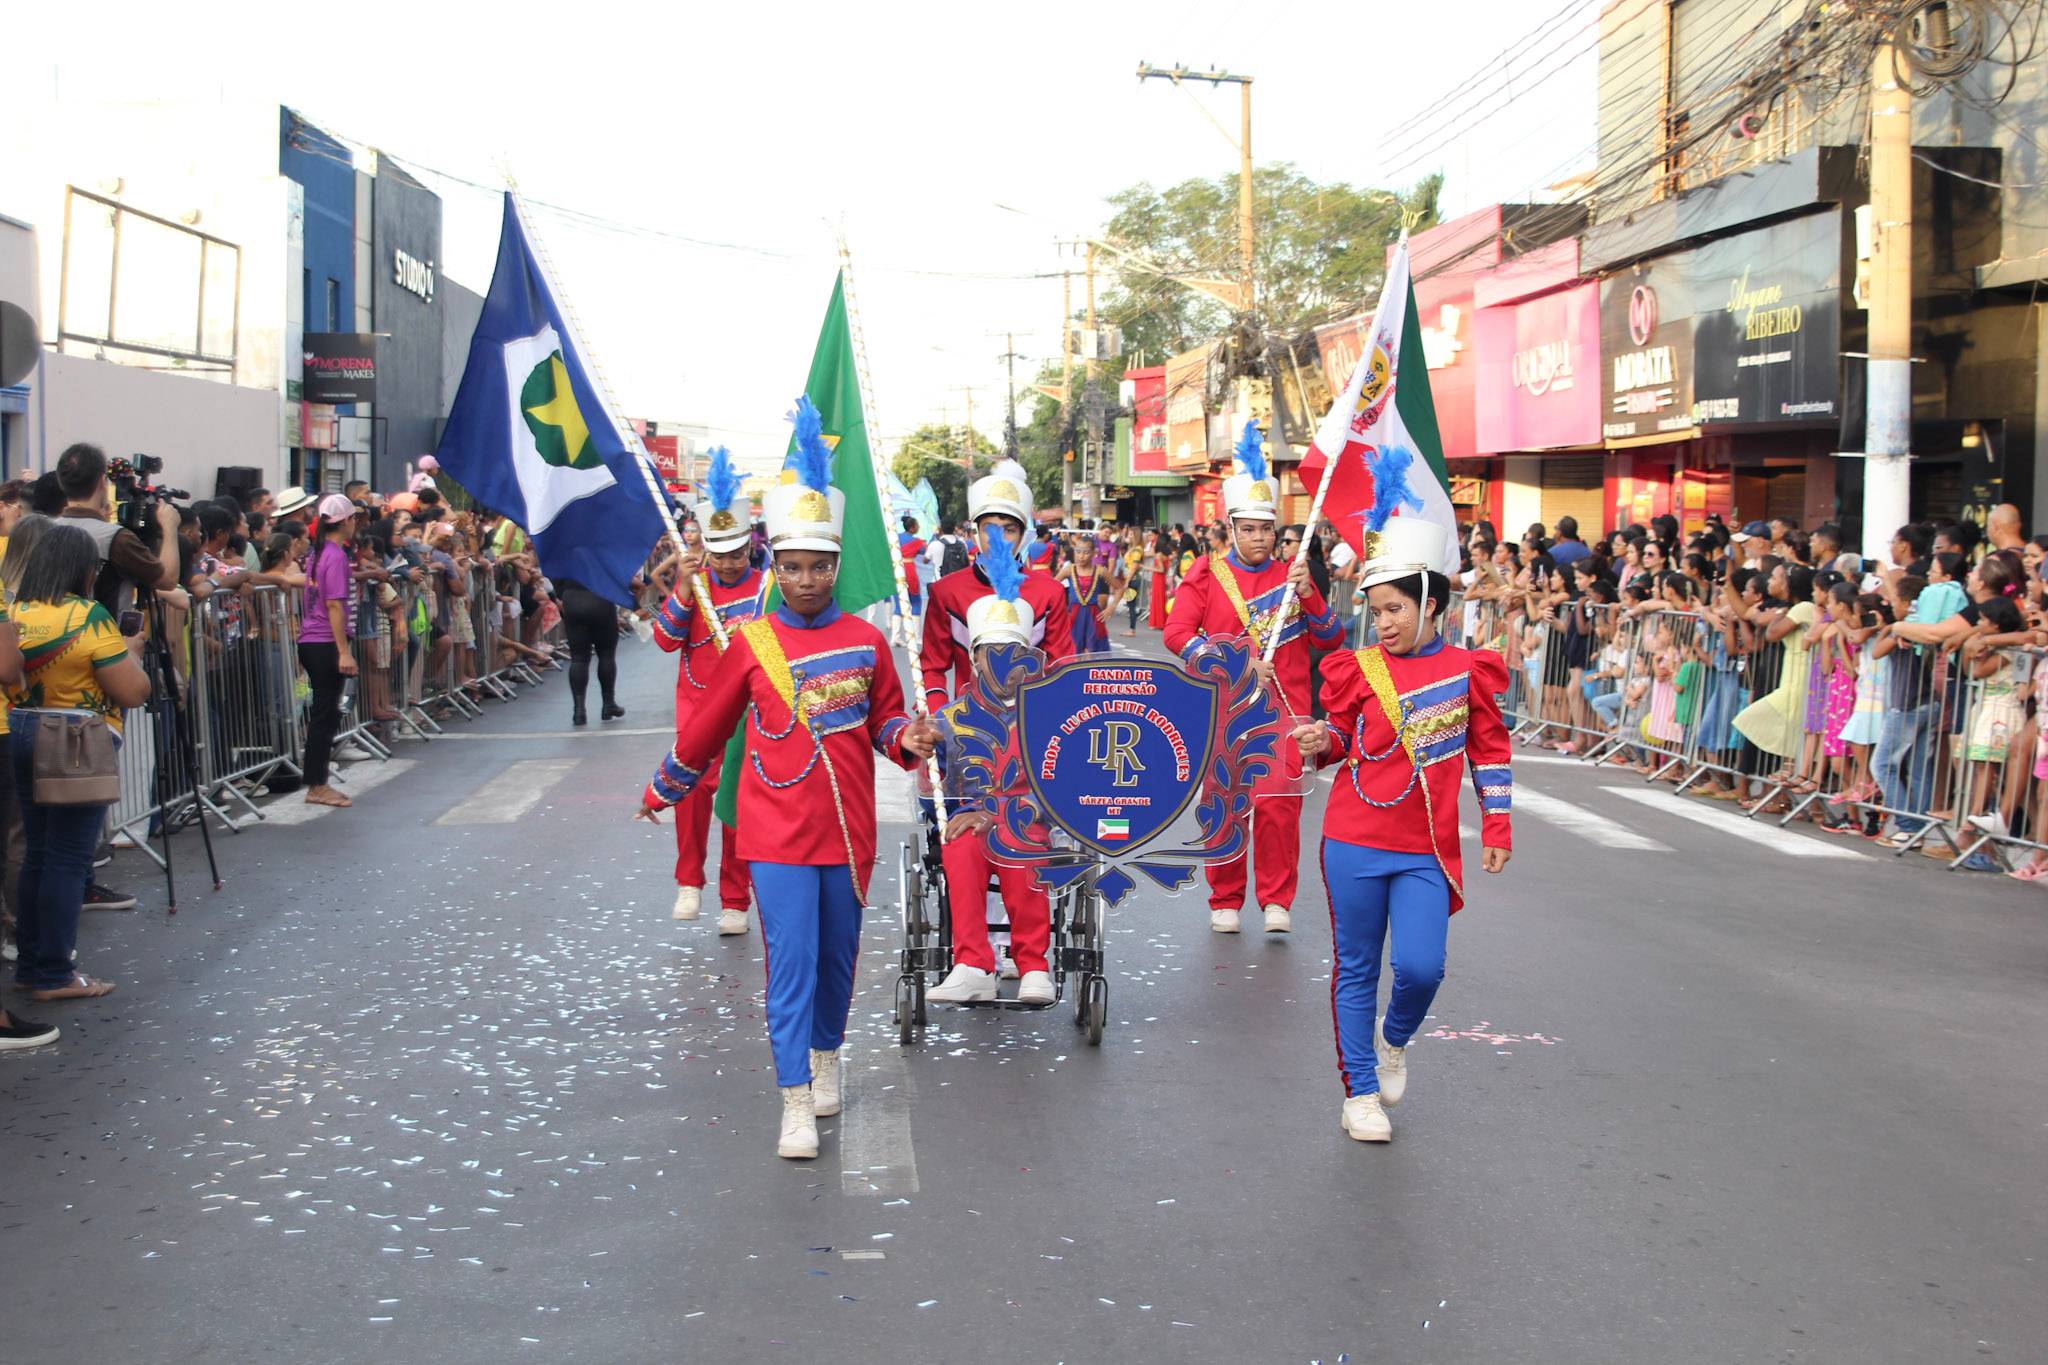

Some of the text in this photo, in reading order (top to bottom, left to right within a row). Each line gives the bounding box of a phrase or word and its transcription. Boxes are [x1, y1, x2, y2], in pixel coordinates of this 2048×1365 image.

[395, 248, 426, 298] STUDIO
[1745, 304, 1802, 340] RIBEIRO
[314, 356, 374, 371] MORENA
[343, 369, 375, 380] MAKES
[1089, 669, 1153, 681] BANDA DE
[1083, 682, 1157, 695] PERCUSSÃO
[1060, 703, 1103, 736] LUCIA
[1103, 700, 1147, 717] LEITE
[1145, 708, 1190, 782] RODRIGUES
[1079, 795, 1151, 806] VÁRZEA GRANDE
[1107, 806, 1122, 816] MT
